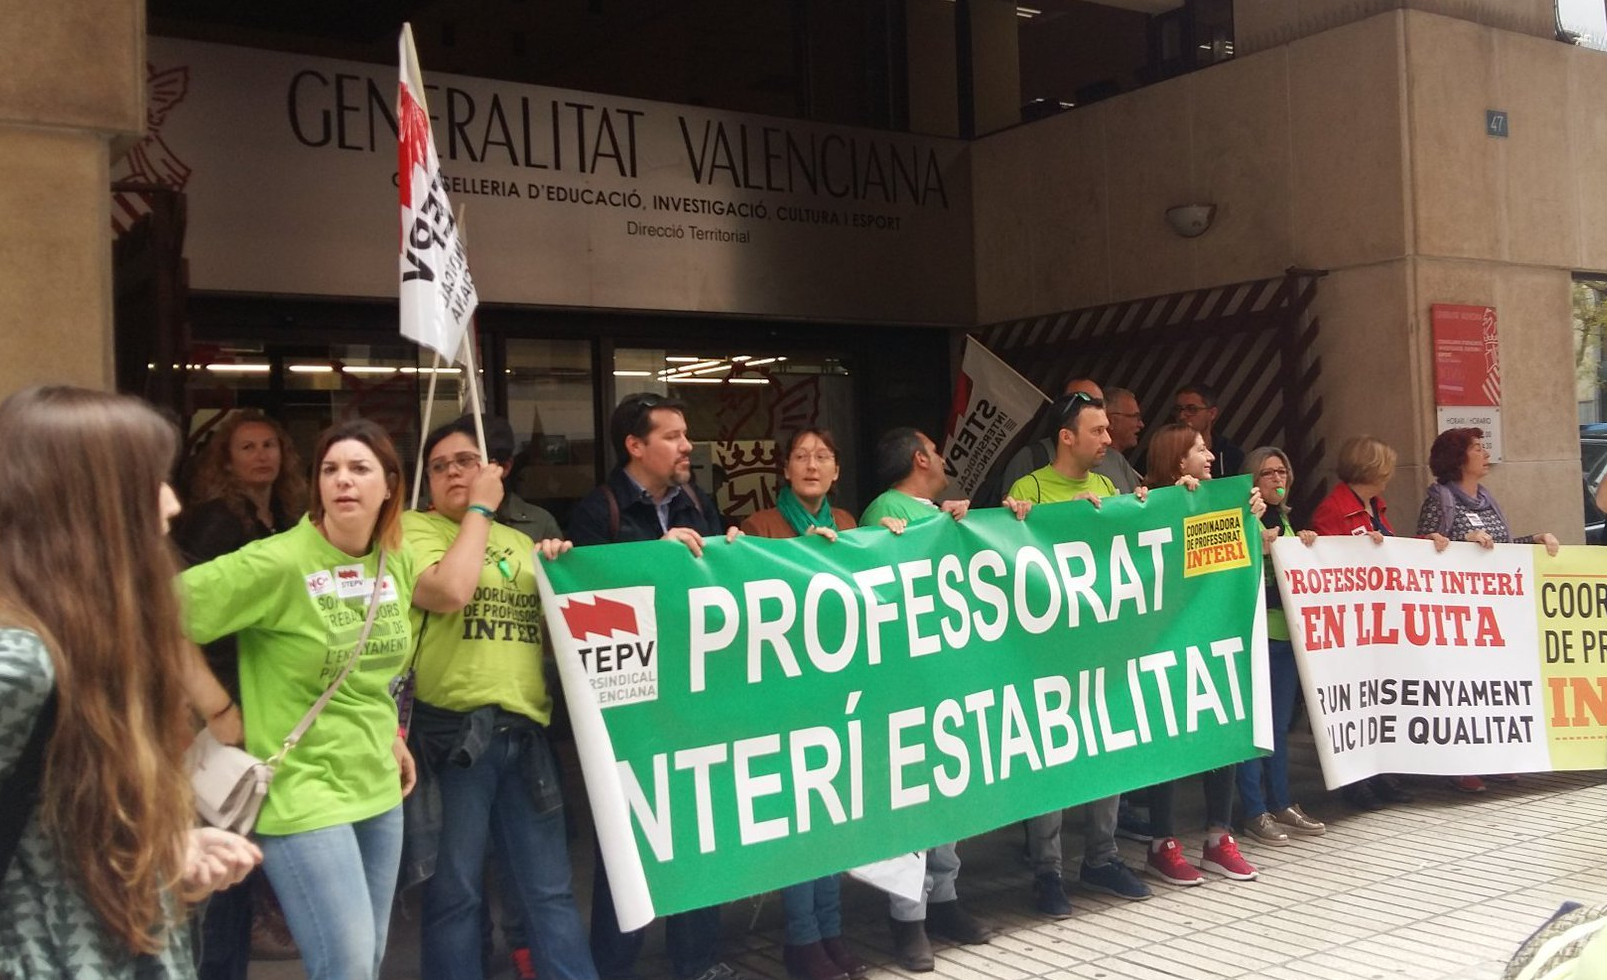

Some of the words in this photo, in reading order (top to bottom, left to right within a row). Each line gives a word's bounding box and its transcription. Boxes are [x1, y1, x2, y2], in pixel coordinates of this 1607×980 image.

[1490, 116, 1504, 131] 47
[678, 115, 949, 209] VALENCIANA
[627, 221, 685, 239] Direcció
[688, 225, 750, 243] Territorial
[776, 206, 840, 226] CULTURA
[852, 213, 901, 231] ESPORT
[1186, 516, 1241, 538] COORDINADORA
[1186, 539, 1194, 551] DE
[1195, 530, 1241, 549] PROFESSORAT
[1284, 566, 1435, 595] ROFESSORAT
[1439, 567, 1525, 596] INTERÍ
[464, 604, 479, 618] DE
[687, 527, 1173, 692] PROFESSORAT
[1300, 604, 1346, 652] EN
[1354, 602, 1506, 647] LLUITA
[1545, 630, 1575, 664] DE
[1359, 679, 1533, 708] ENSENYAMENT
[888, 636, 1246, 810] ESTABILITAT
[1368, 715, 1397, 746] DE
[1408, 715, 1534, 746] QUALITAT
